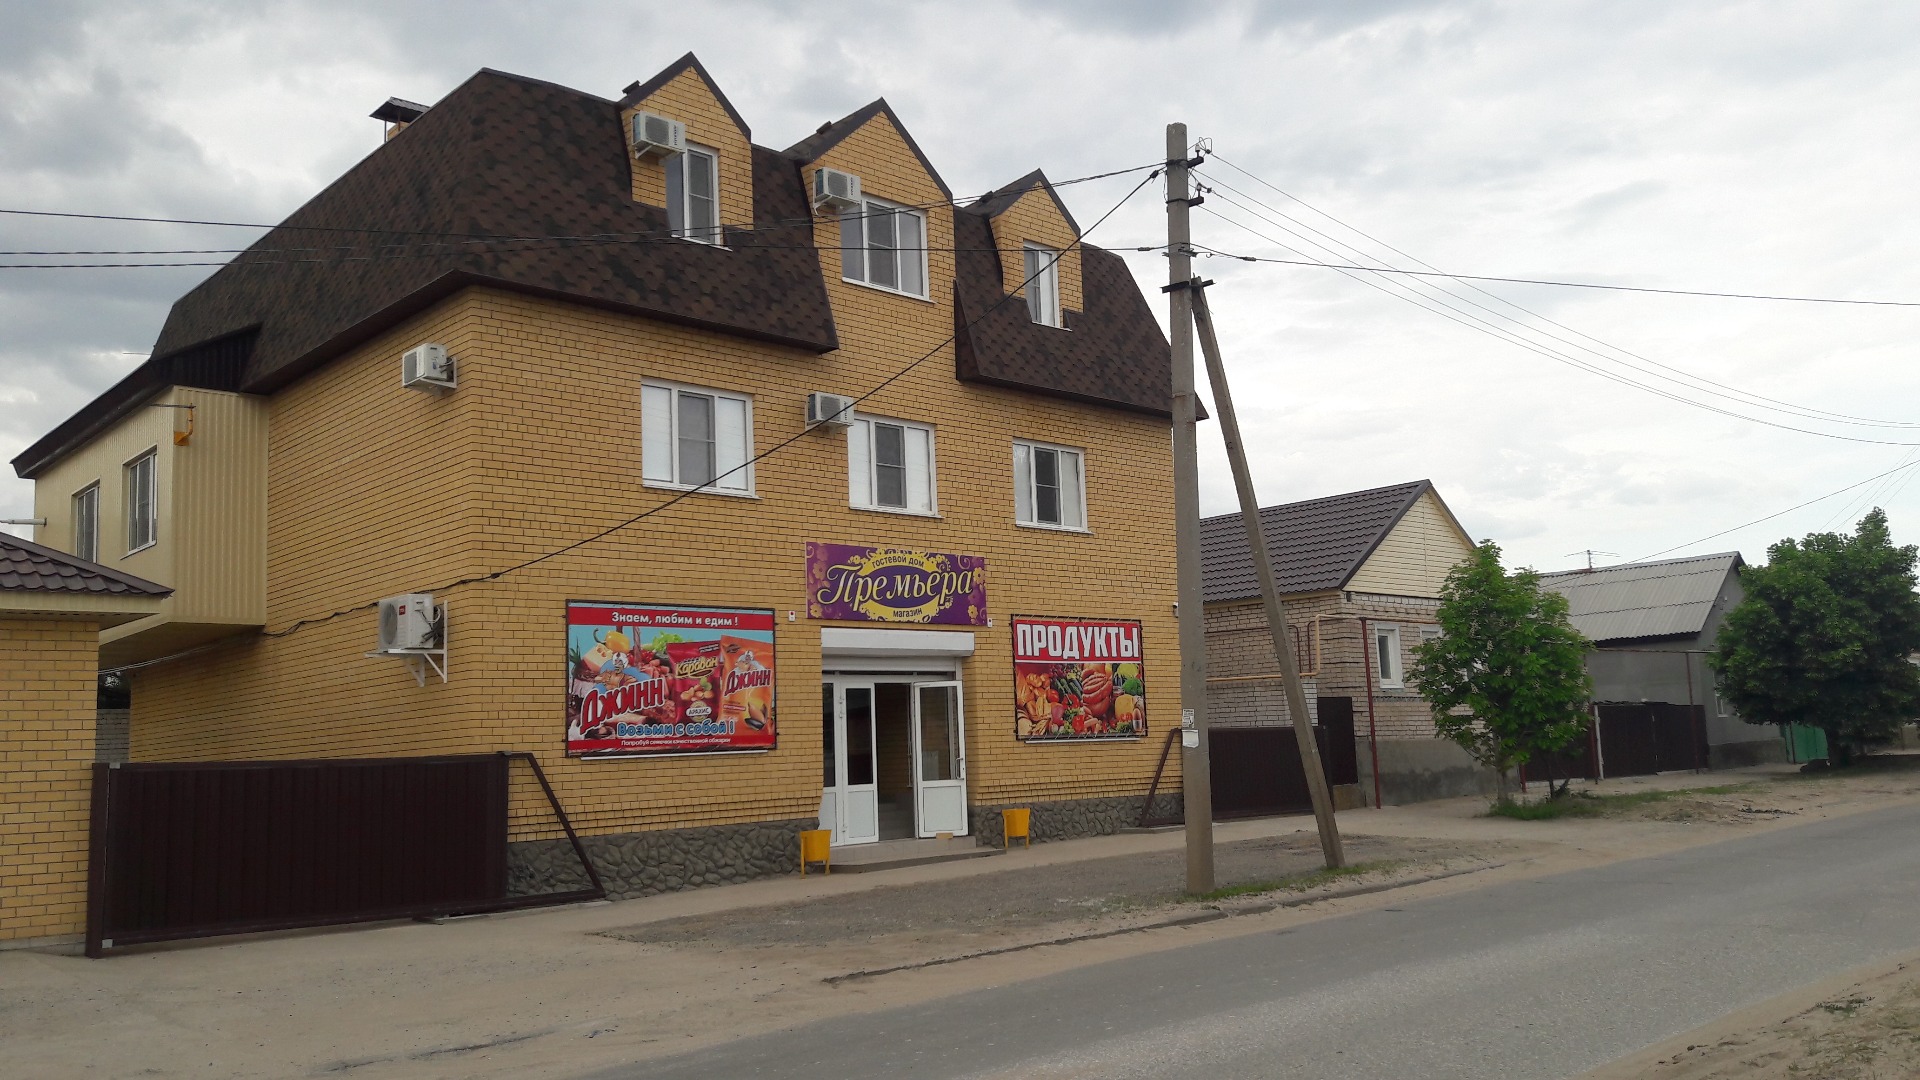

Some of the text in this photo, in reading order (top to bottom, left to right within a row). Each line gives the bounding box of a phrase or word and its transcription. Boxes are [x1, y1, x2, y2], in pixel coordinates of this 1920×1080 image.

[872, 555, 925, 569] гостевой дом
[817, 564, 974, 612] Премьера
[612, 612, 652, 624] Знаем,
[655, 613, 693, 625] любим
[695, 617, 702, 625] и
[705, 618, 732, 627] едим
[892, 608, 923, 618] магазин
[1016, 623, 1140, 660] ПРОДУКТЫ
[675, 656, 718, 677] Караван
[688, 707, 710, 715] АРАХИС
[617, 722, 673, 737] Возьми
[675, 724, 684, 736] с
[685, 719, 727, 735] собой
